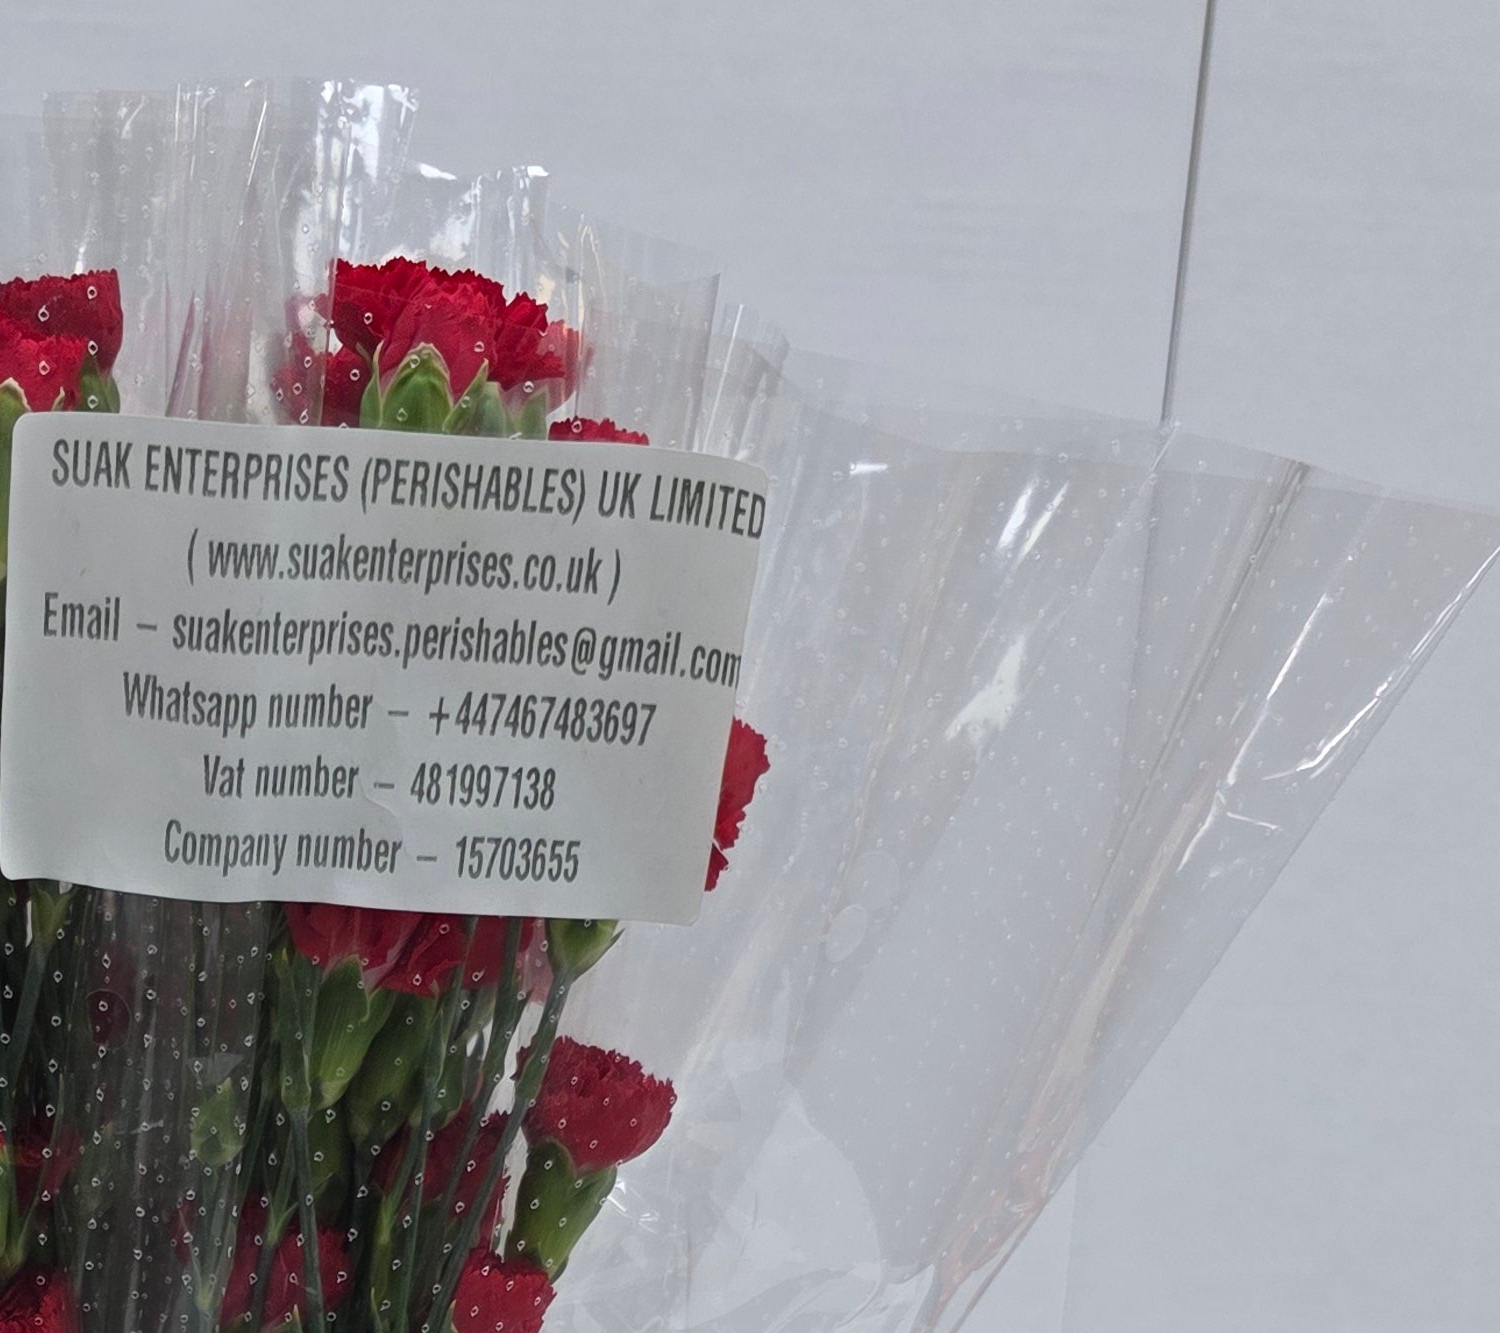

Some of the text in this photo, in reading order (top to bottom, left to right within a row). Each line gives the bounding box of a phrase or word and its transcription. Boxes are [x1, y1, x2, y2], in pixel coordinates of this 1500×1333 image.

[52, 438, 766, 539] SUAK ENTERPRISES (PERISHABLES) UK LIMITED
[208, 533, 603, 595] www.suakenterprises.co.uk
[43, 591, 121, 641] Email
[171, 609, 742, 690] suakenterprises.perishables@gmail.com
[122, 671, 257, 738] Whatsapp
[268, 684, 374, 729] number
[429, 691, 657, 746] +447467483697
[203, 754, 245, 798] Vat
[255, 755, 360, 799] number
[410, 762, 556, 811] 481997138
[164, 819, 288, 877] Company
[296, 827, 403, 874] number
[456, 835, 581, 883] 15703655
